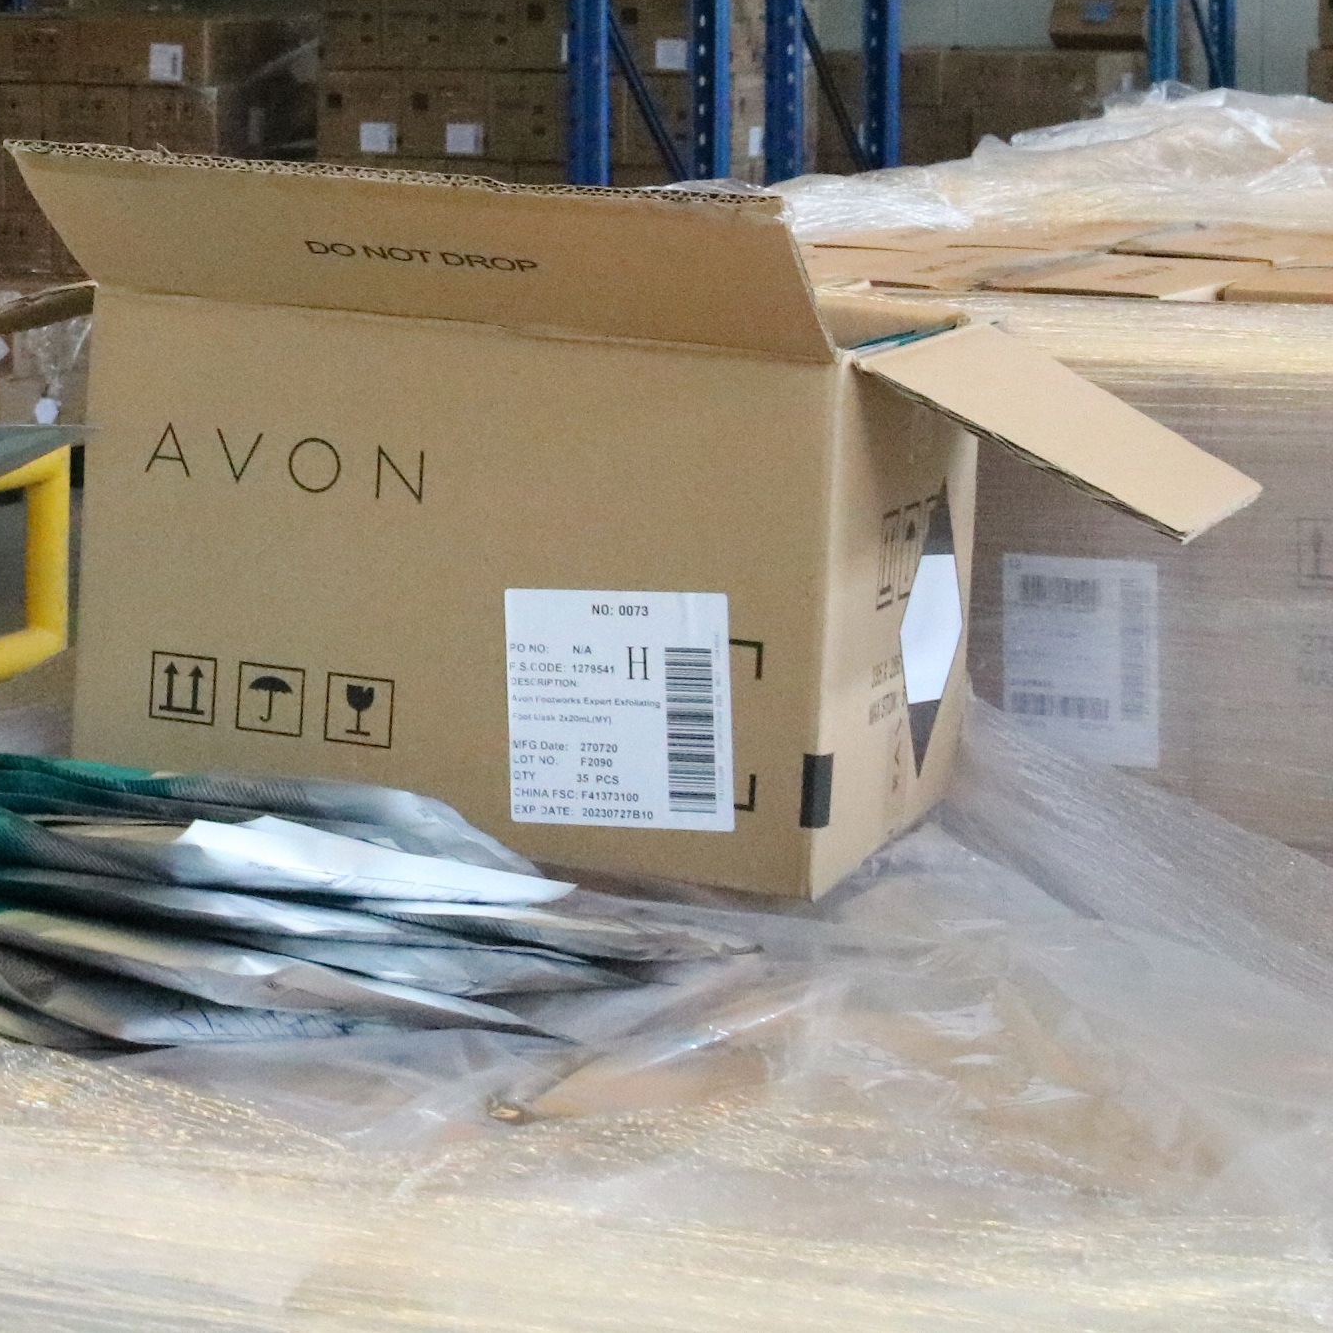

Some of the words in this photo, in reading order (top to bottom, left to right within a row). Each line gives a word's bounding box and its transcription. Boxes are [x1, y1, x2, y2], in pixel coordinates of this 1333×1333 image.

[305, 240, 356, 257] DO
[362, 244, 431, 265] NOT
[439, 251, 538, 273] DROP
[145, 422, 425, 504] AVON
[591, 604, 614, 616] NO:
[618, 605, 649, 617] 0073
[572, 645, 592, 655] N/A
[572, 664, 615, 674] 1279541
[626, 646, 650, 681] H
[583, 697, 612, 707] Expert
[513, 740, 537, 750] MFG
[540, 741, 569, 751] Date:
[580, 743, 618, 753] 270720
[580, 757, 613, 768] F2090
[576, 774, 589, 783] 35
[596, 775, 620, 785] PCS
[514, 788, 550, 798] CHINA
[581, 791, 639, 802] F41373100
[514, 804, 536, 815] EXP
[582, 807, 654, 820] 20230727B10
